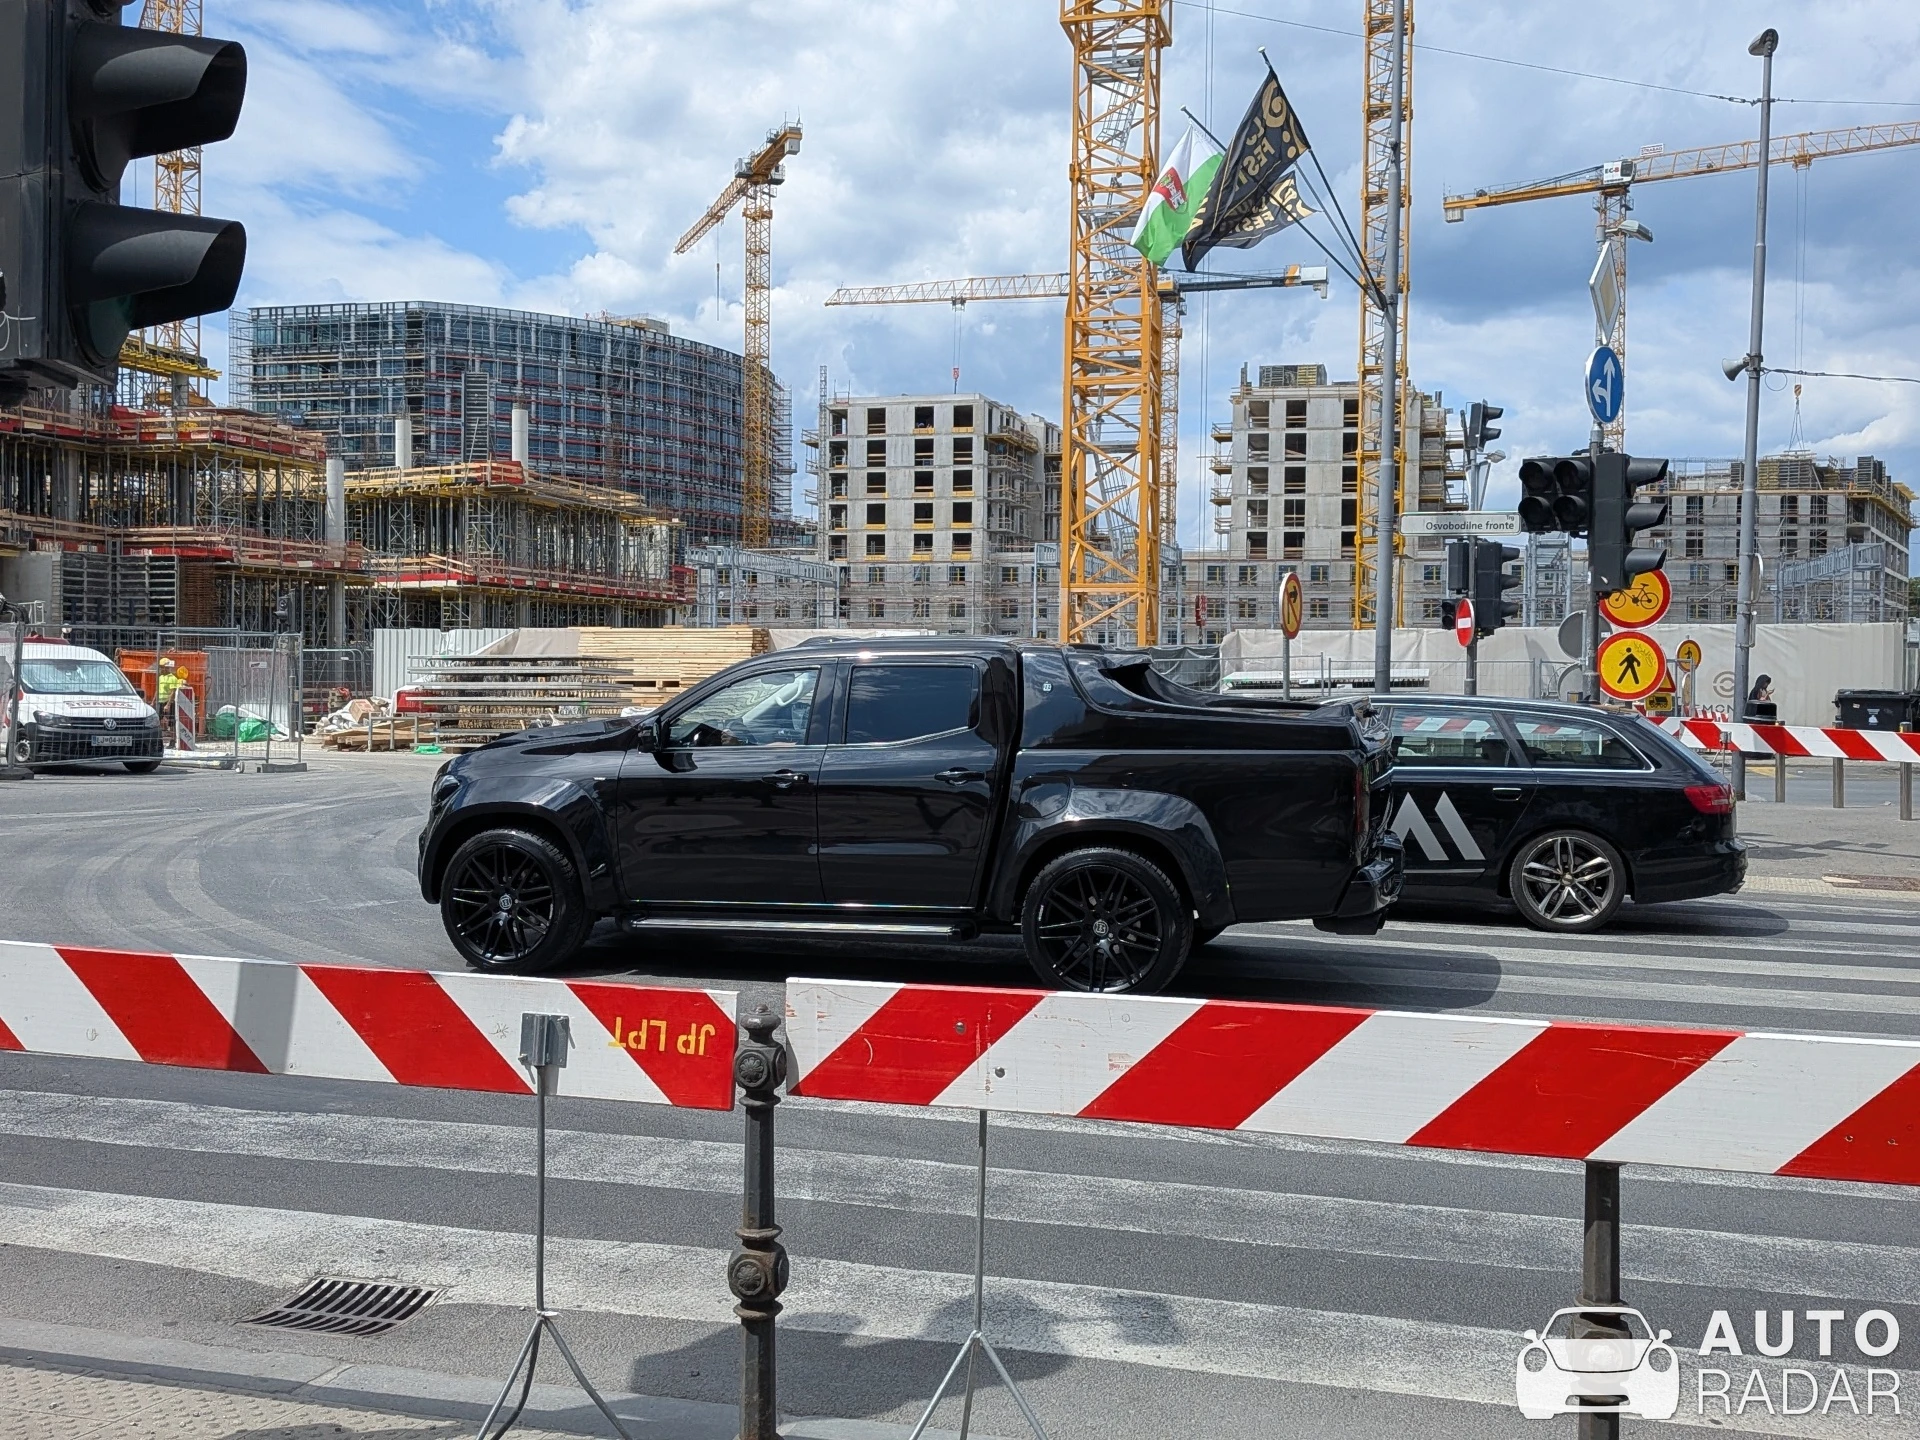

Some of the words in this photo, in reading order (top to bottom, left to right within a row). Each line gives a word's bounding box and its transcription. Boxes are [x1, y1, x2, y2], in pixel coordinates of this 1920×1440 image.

[1425, 521, 1483, 530] Osvobodilne
[1485, 521, 1515, 530] fronte
[1695, 704, 1735, 714] MON
[607, 1016, 668, 1052] LPT
[676, 1022, 716, 1056] JP
